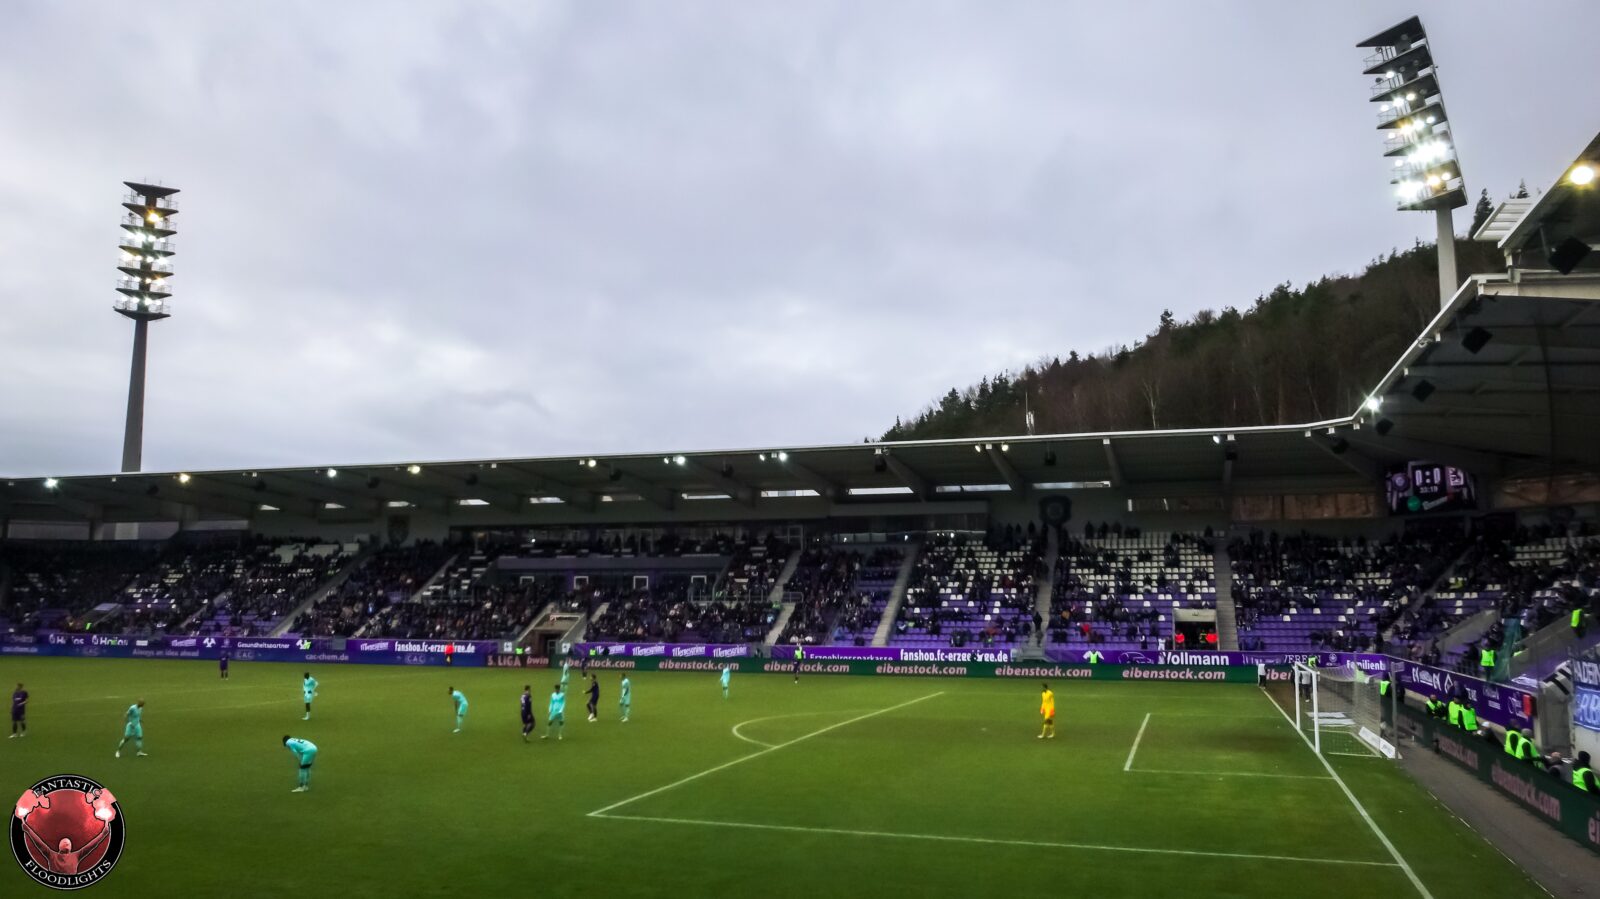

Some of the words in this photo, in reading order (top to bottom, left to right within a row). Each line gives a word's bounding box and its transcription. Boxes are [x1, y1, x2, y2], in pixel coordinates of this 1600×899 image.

[498, 655, 522, 666] LIGA
[526, 655, 549, 665] bwin
[875, 663, 967, 675] eibenstock.com
[994, 665, 1093, 678] eibenstock.com
[1122, 667, 1226, 680] eibenstock.com
